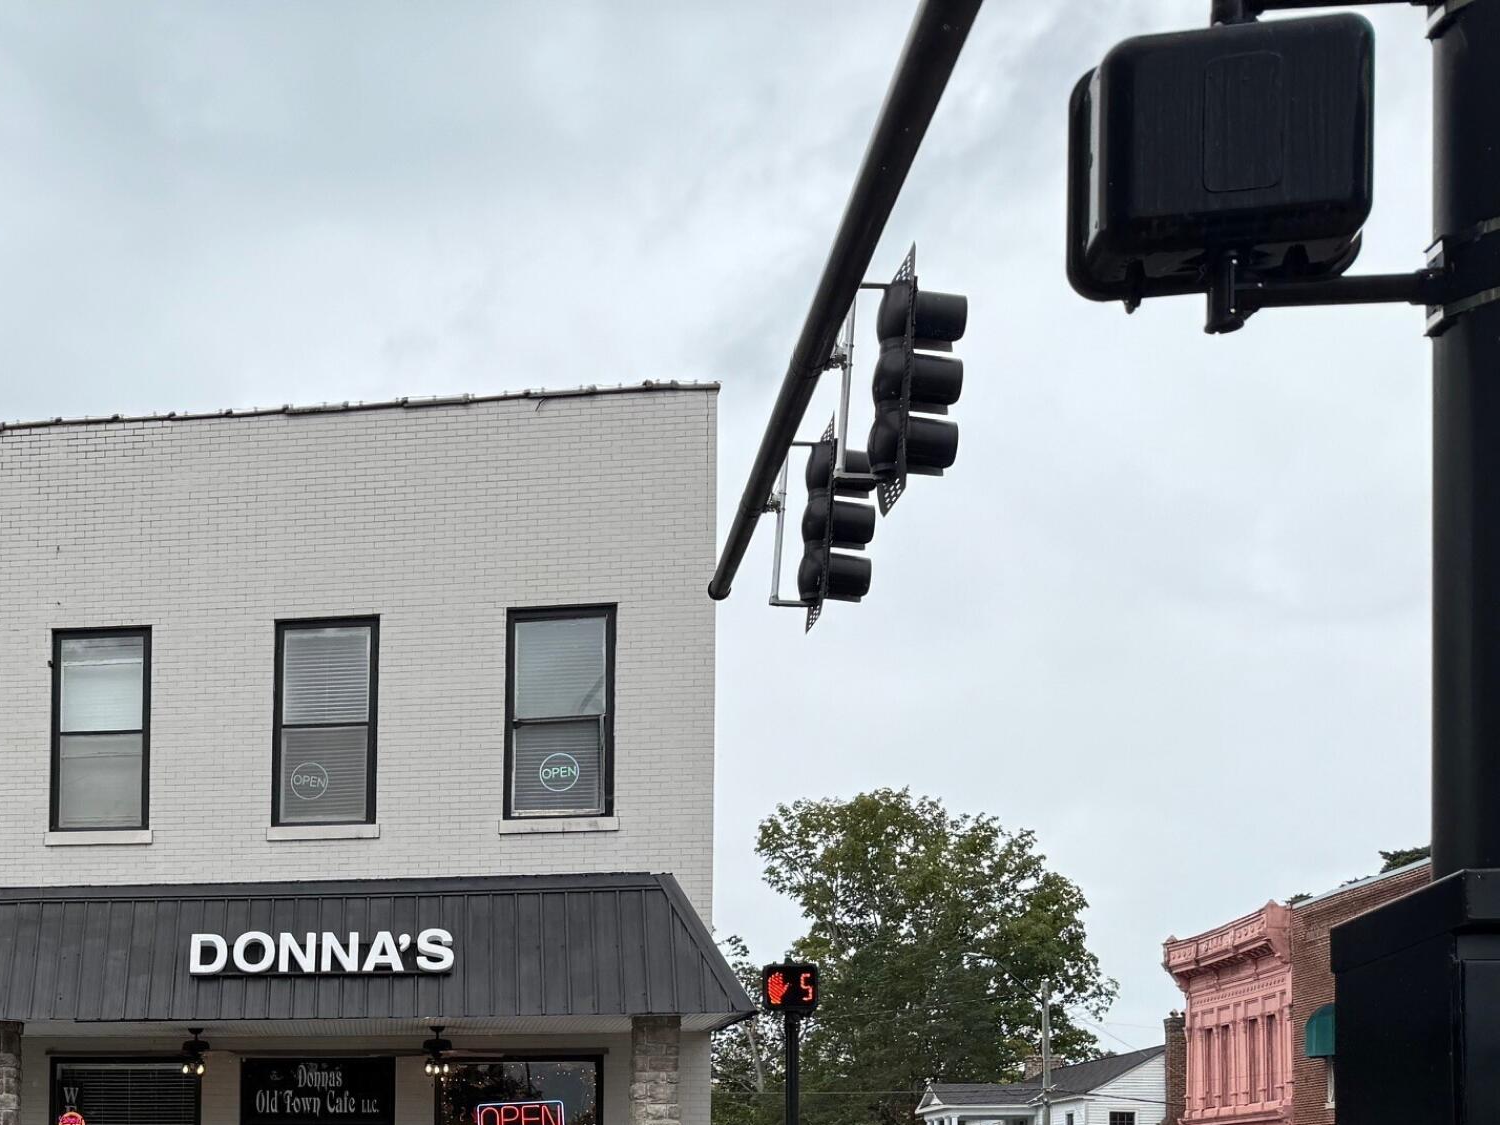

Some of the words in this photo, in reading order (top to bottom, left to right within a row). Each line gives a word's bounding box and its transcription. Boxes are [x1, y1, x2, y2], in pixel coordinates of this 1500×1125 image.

[293, 774, 326, 788] OPEN
[542, 766, 576, 779] OPEN
[189, 928, 455, 973] DONNA'S
[800, 973, 813, 1000] 5
[256, 1089, 278, 1113] Old
[283, 1089, 320, 1117] Town
[327, 1089, 356, 1113] Cafe
